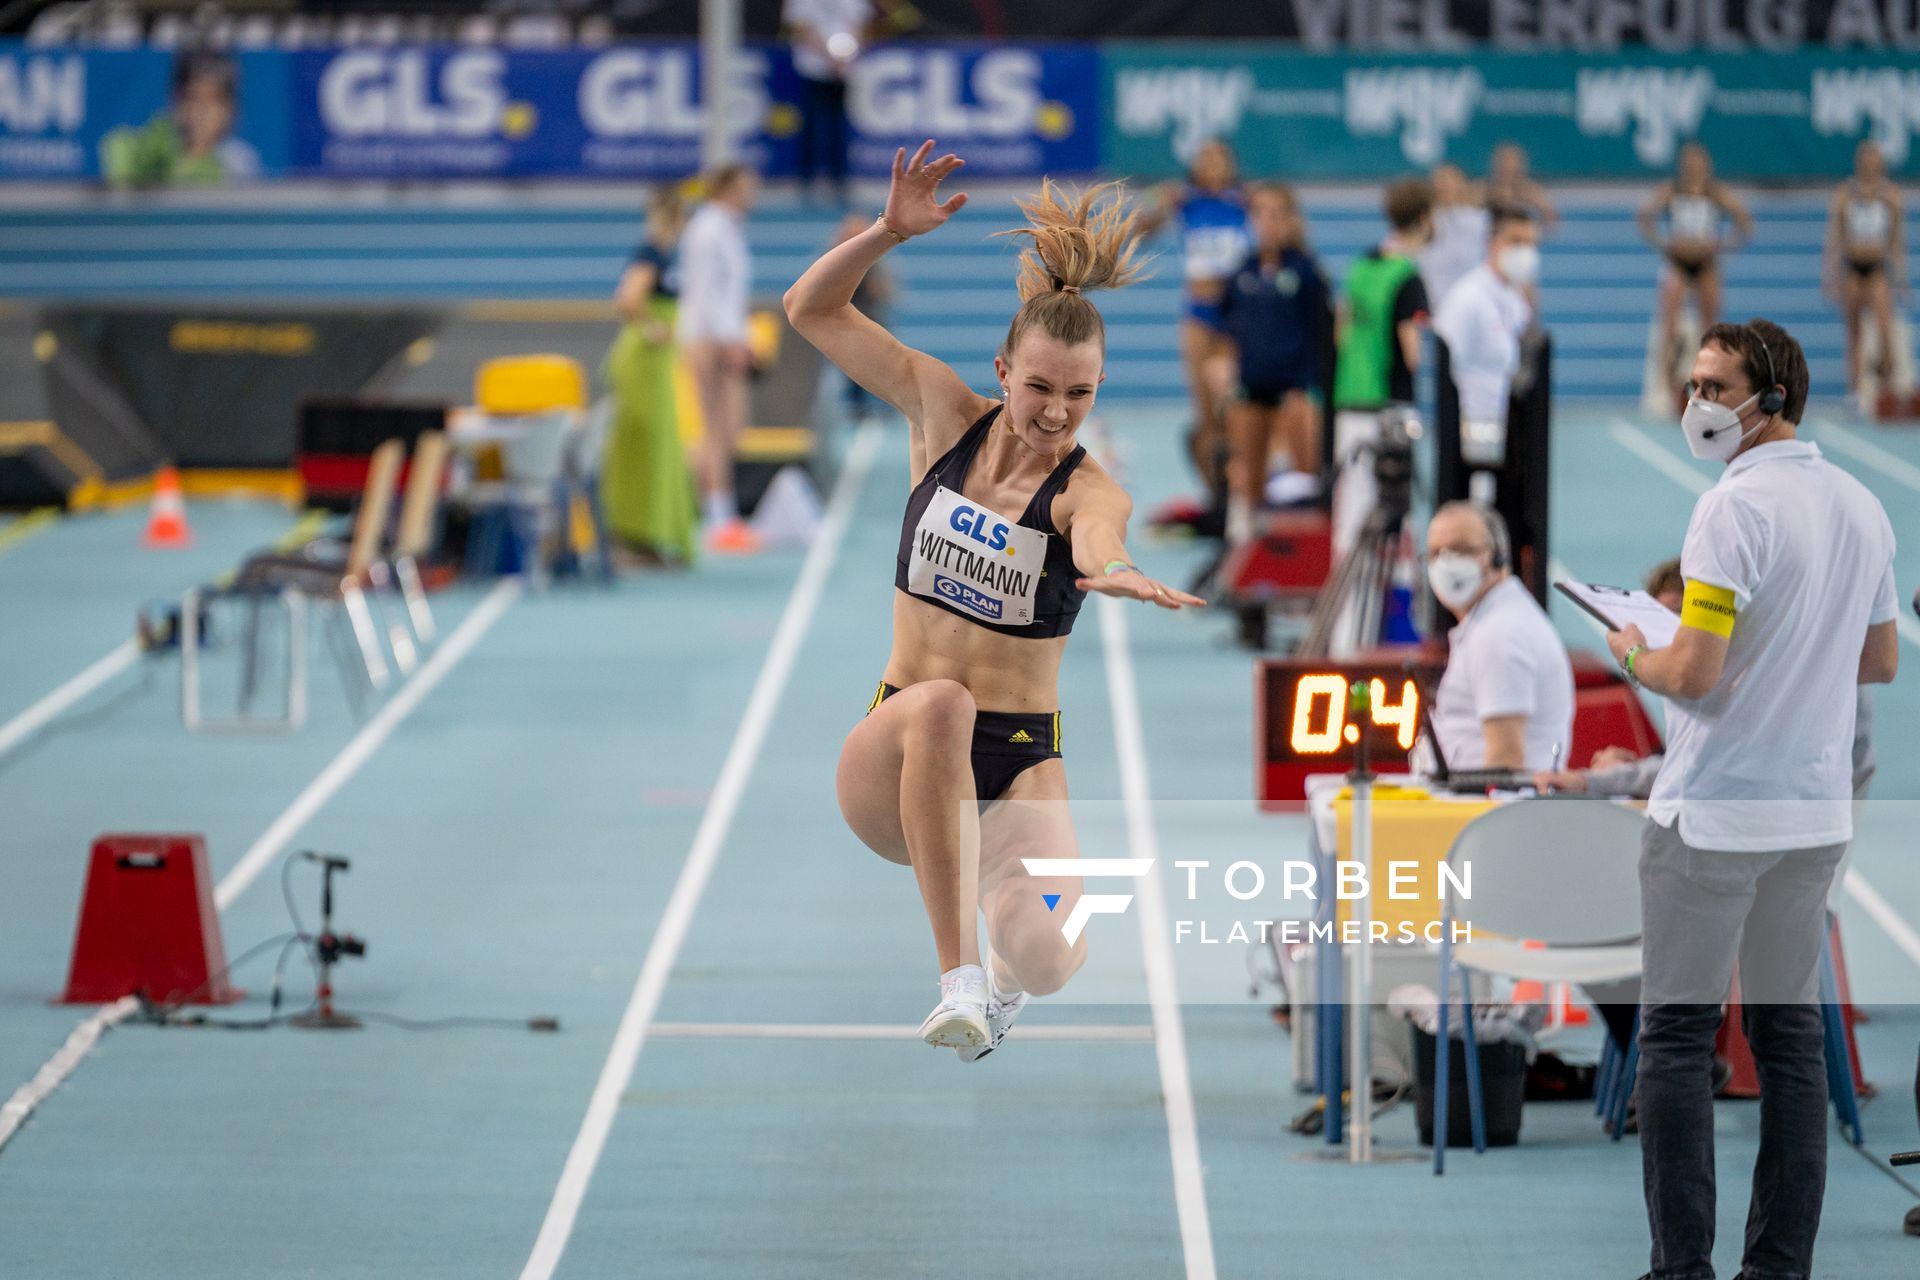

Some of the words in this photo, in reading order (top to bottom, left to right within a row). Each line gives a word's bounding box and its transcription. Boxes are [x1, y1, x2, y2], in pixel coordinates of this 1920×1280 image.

[1293, 0, 1478, 52] VIEL
[919, 529, 1032, 597] WITTMANN
[963, 588, 999, 613] PLAN
